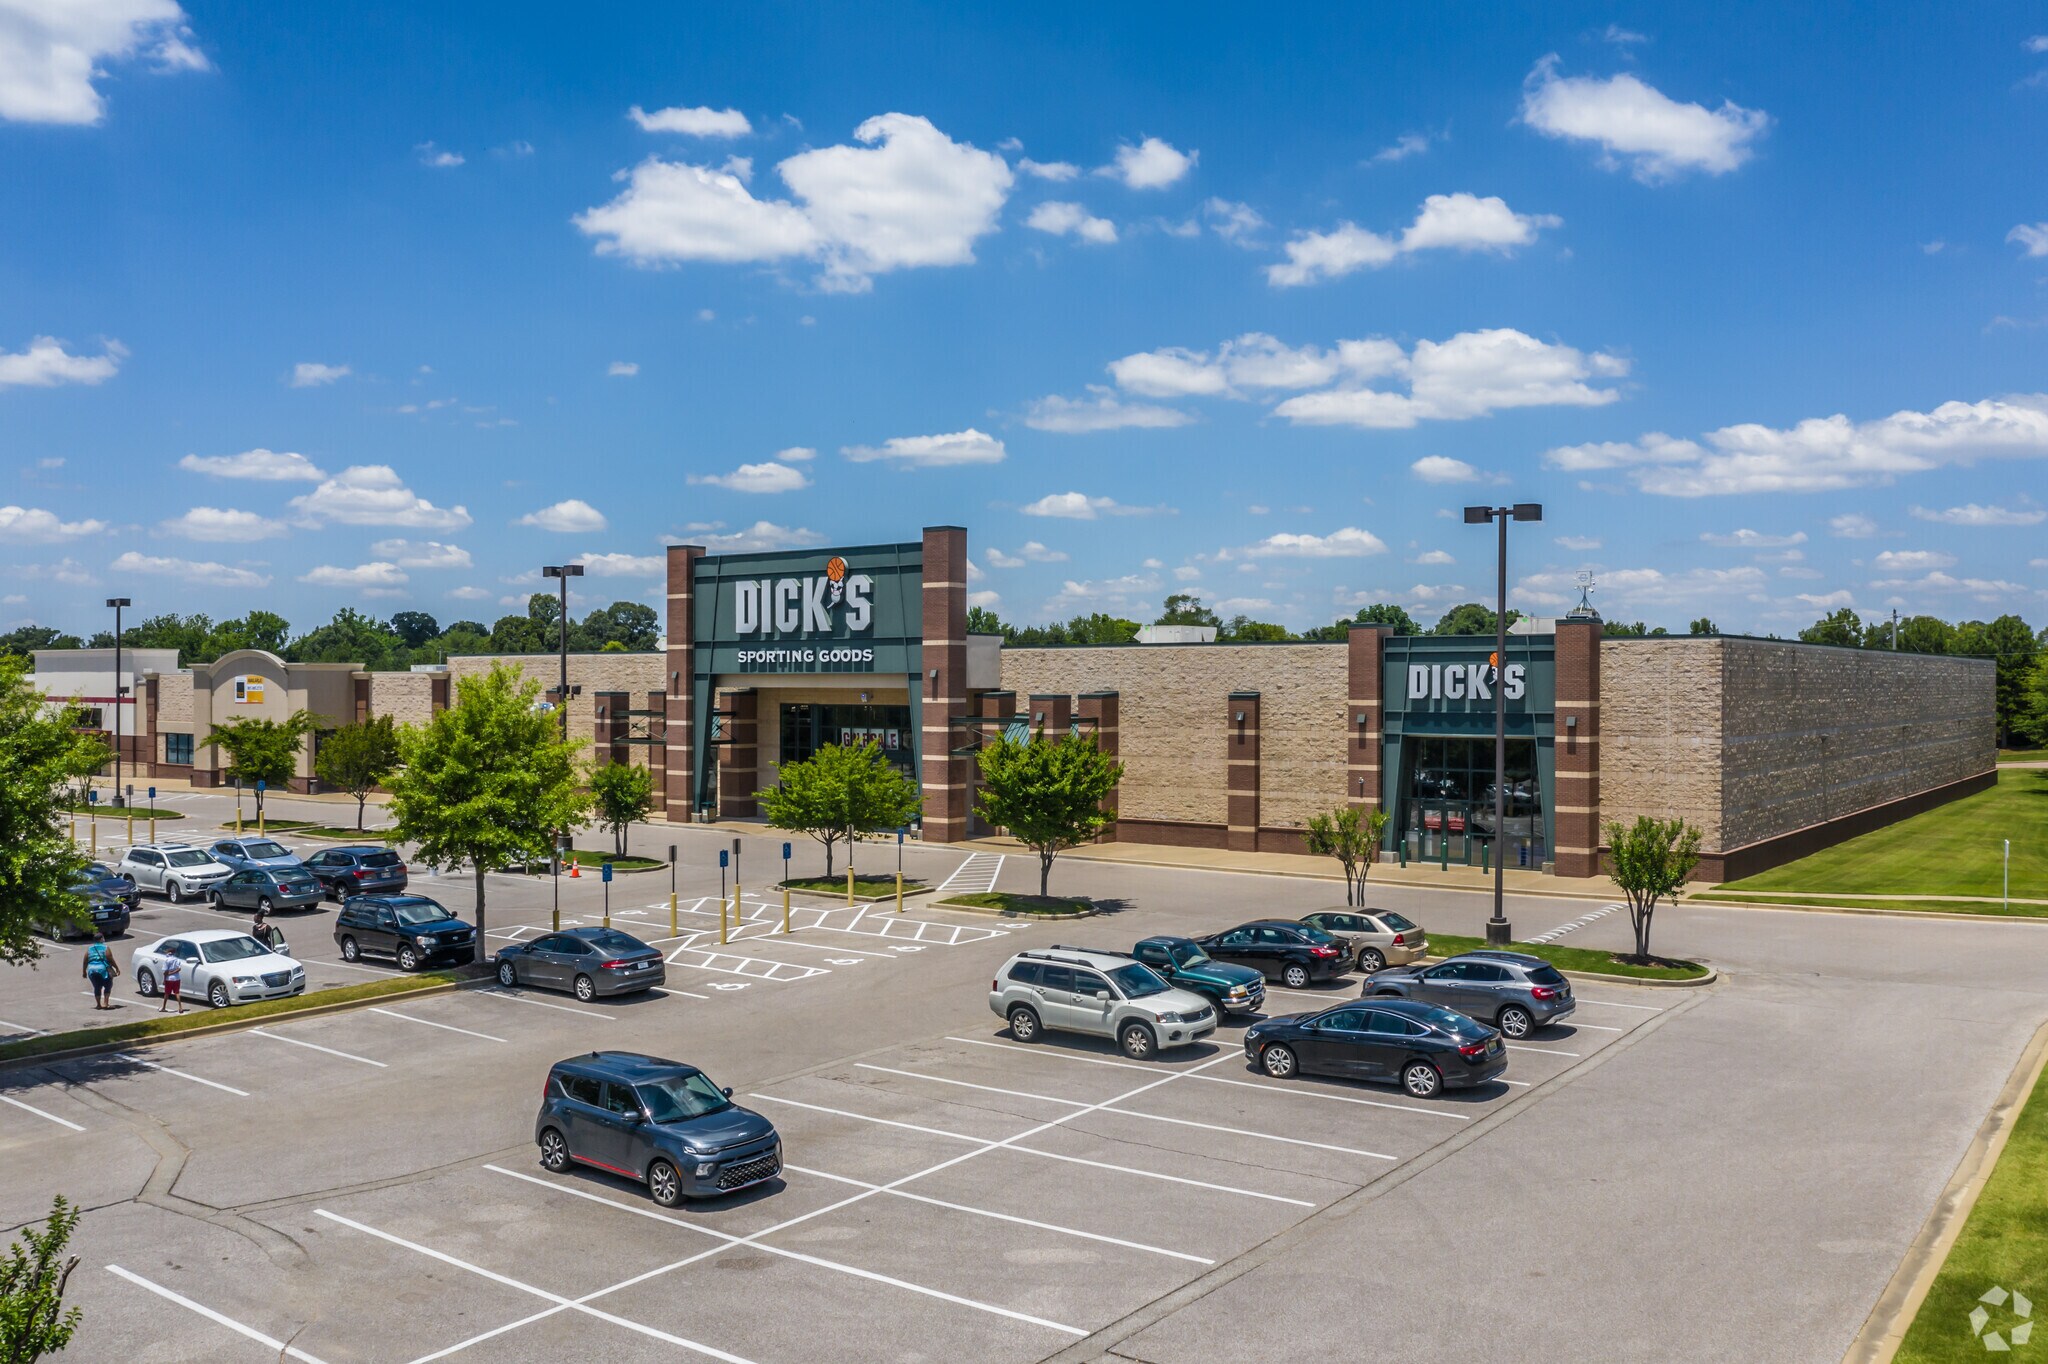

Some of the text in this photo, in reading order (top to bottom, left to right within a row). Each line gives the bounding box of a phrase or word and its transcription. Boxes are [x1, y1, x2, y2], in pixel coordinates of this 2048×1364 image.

[735, 557, 875, 634] DICK'S
[738, 649, 873, 663] SPORTING GOODS
[1408, 653, 1526, 700] DICK'S
[843, 732, 869, 748] GF
